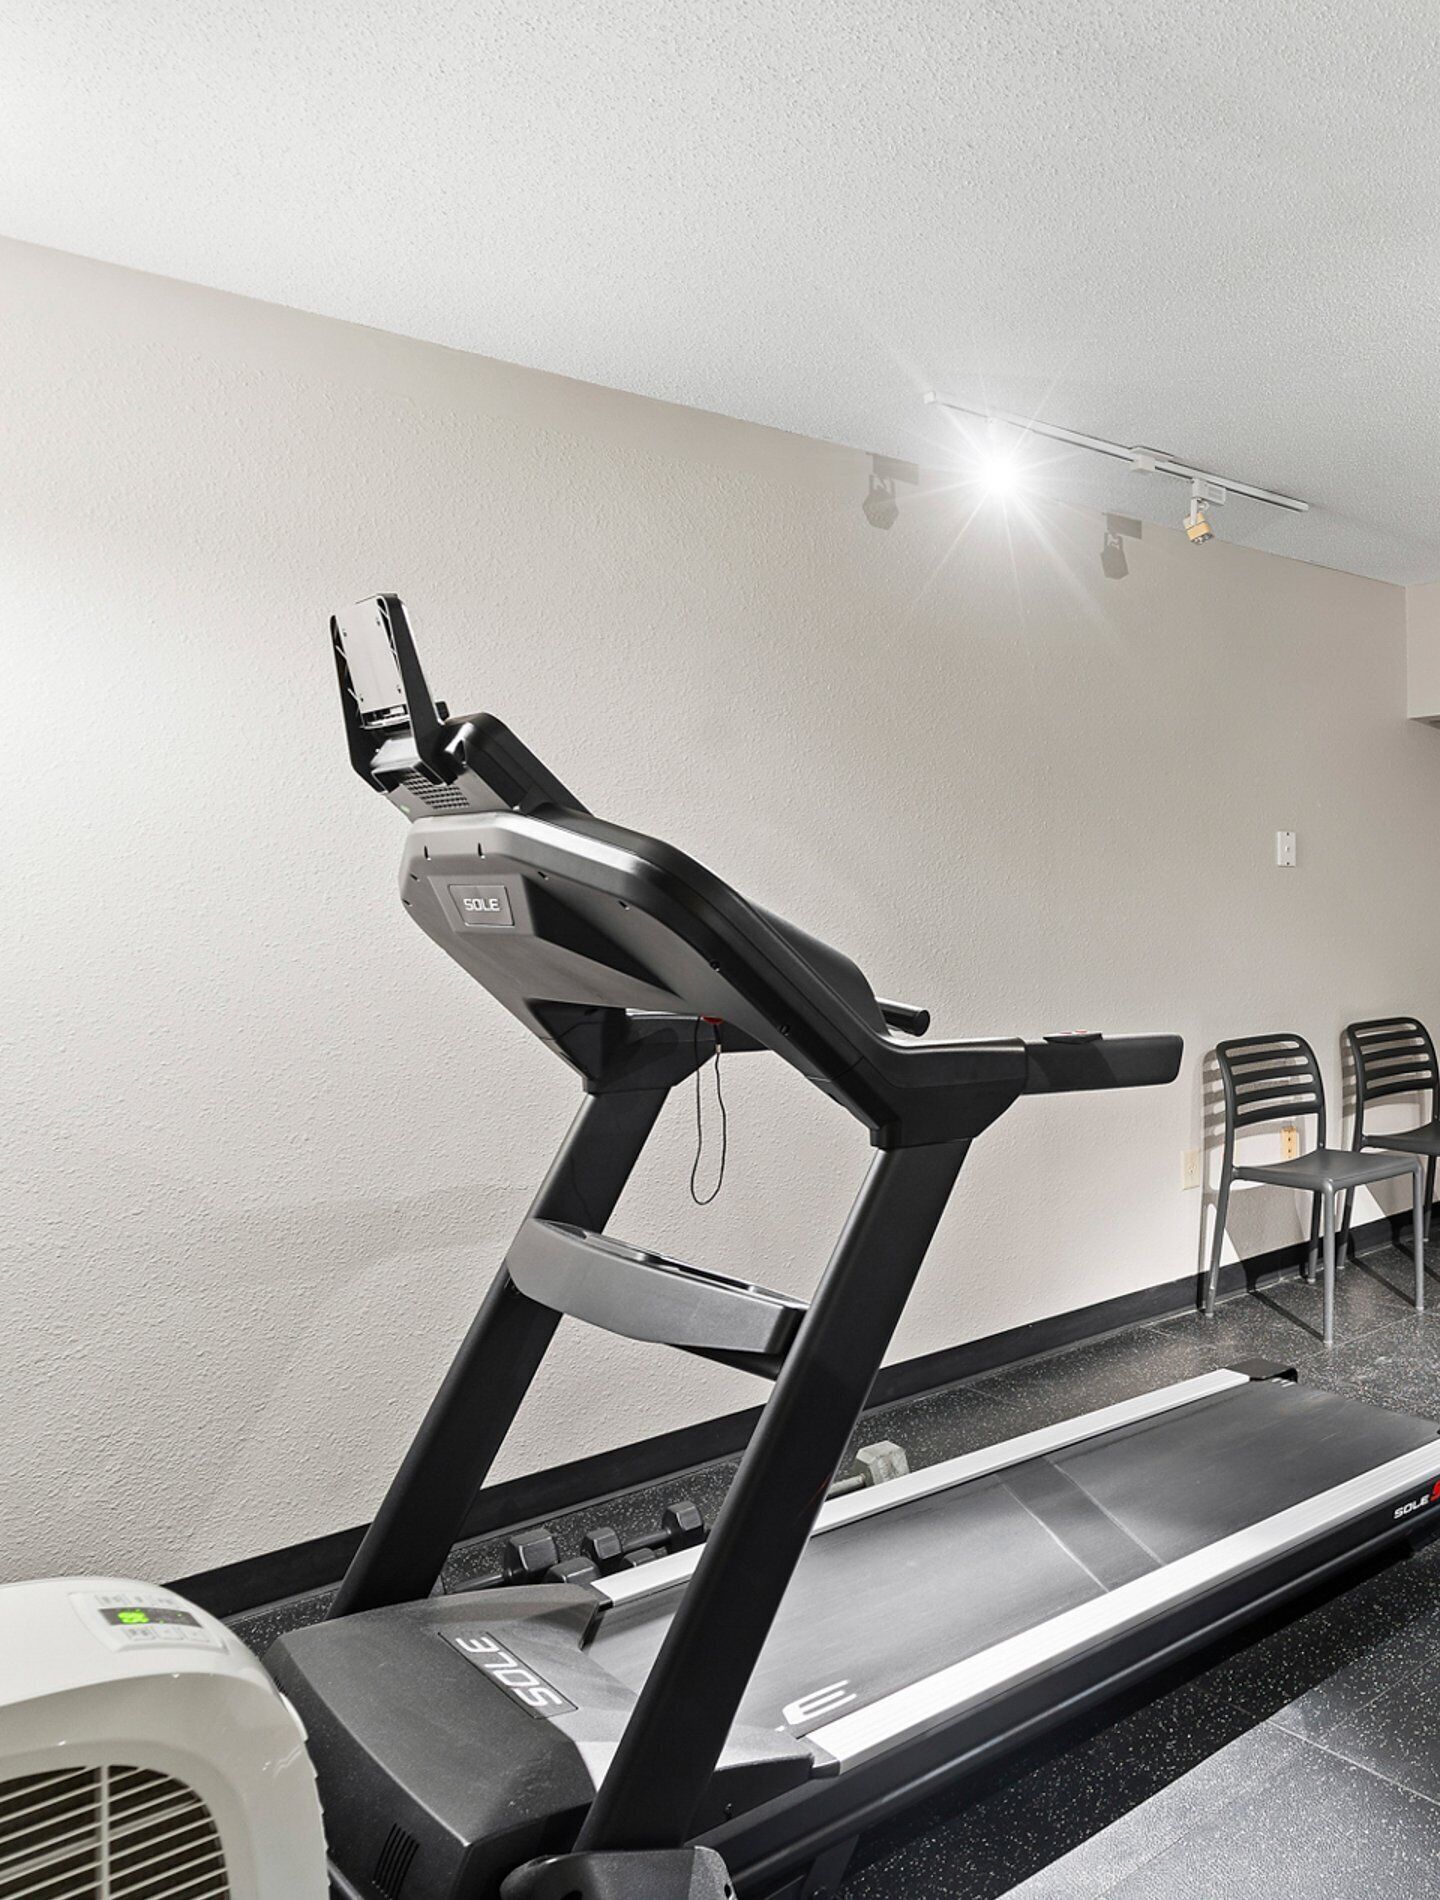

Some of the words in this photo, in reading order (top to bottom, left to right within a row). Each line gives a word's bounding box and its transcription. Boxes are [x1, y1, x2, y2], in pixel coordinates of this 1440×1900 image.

[463, 898, 500, 912] SOLE
[1393, 1493, 1430, 1520] SOLE
[455, 1636, 563, 1707] SOLE
